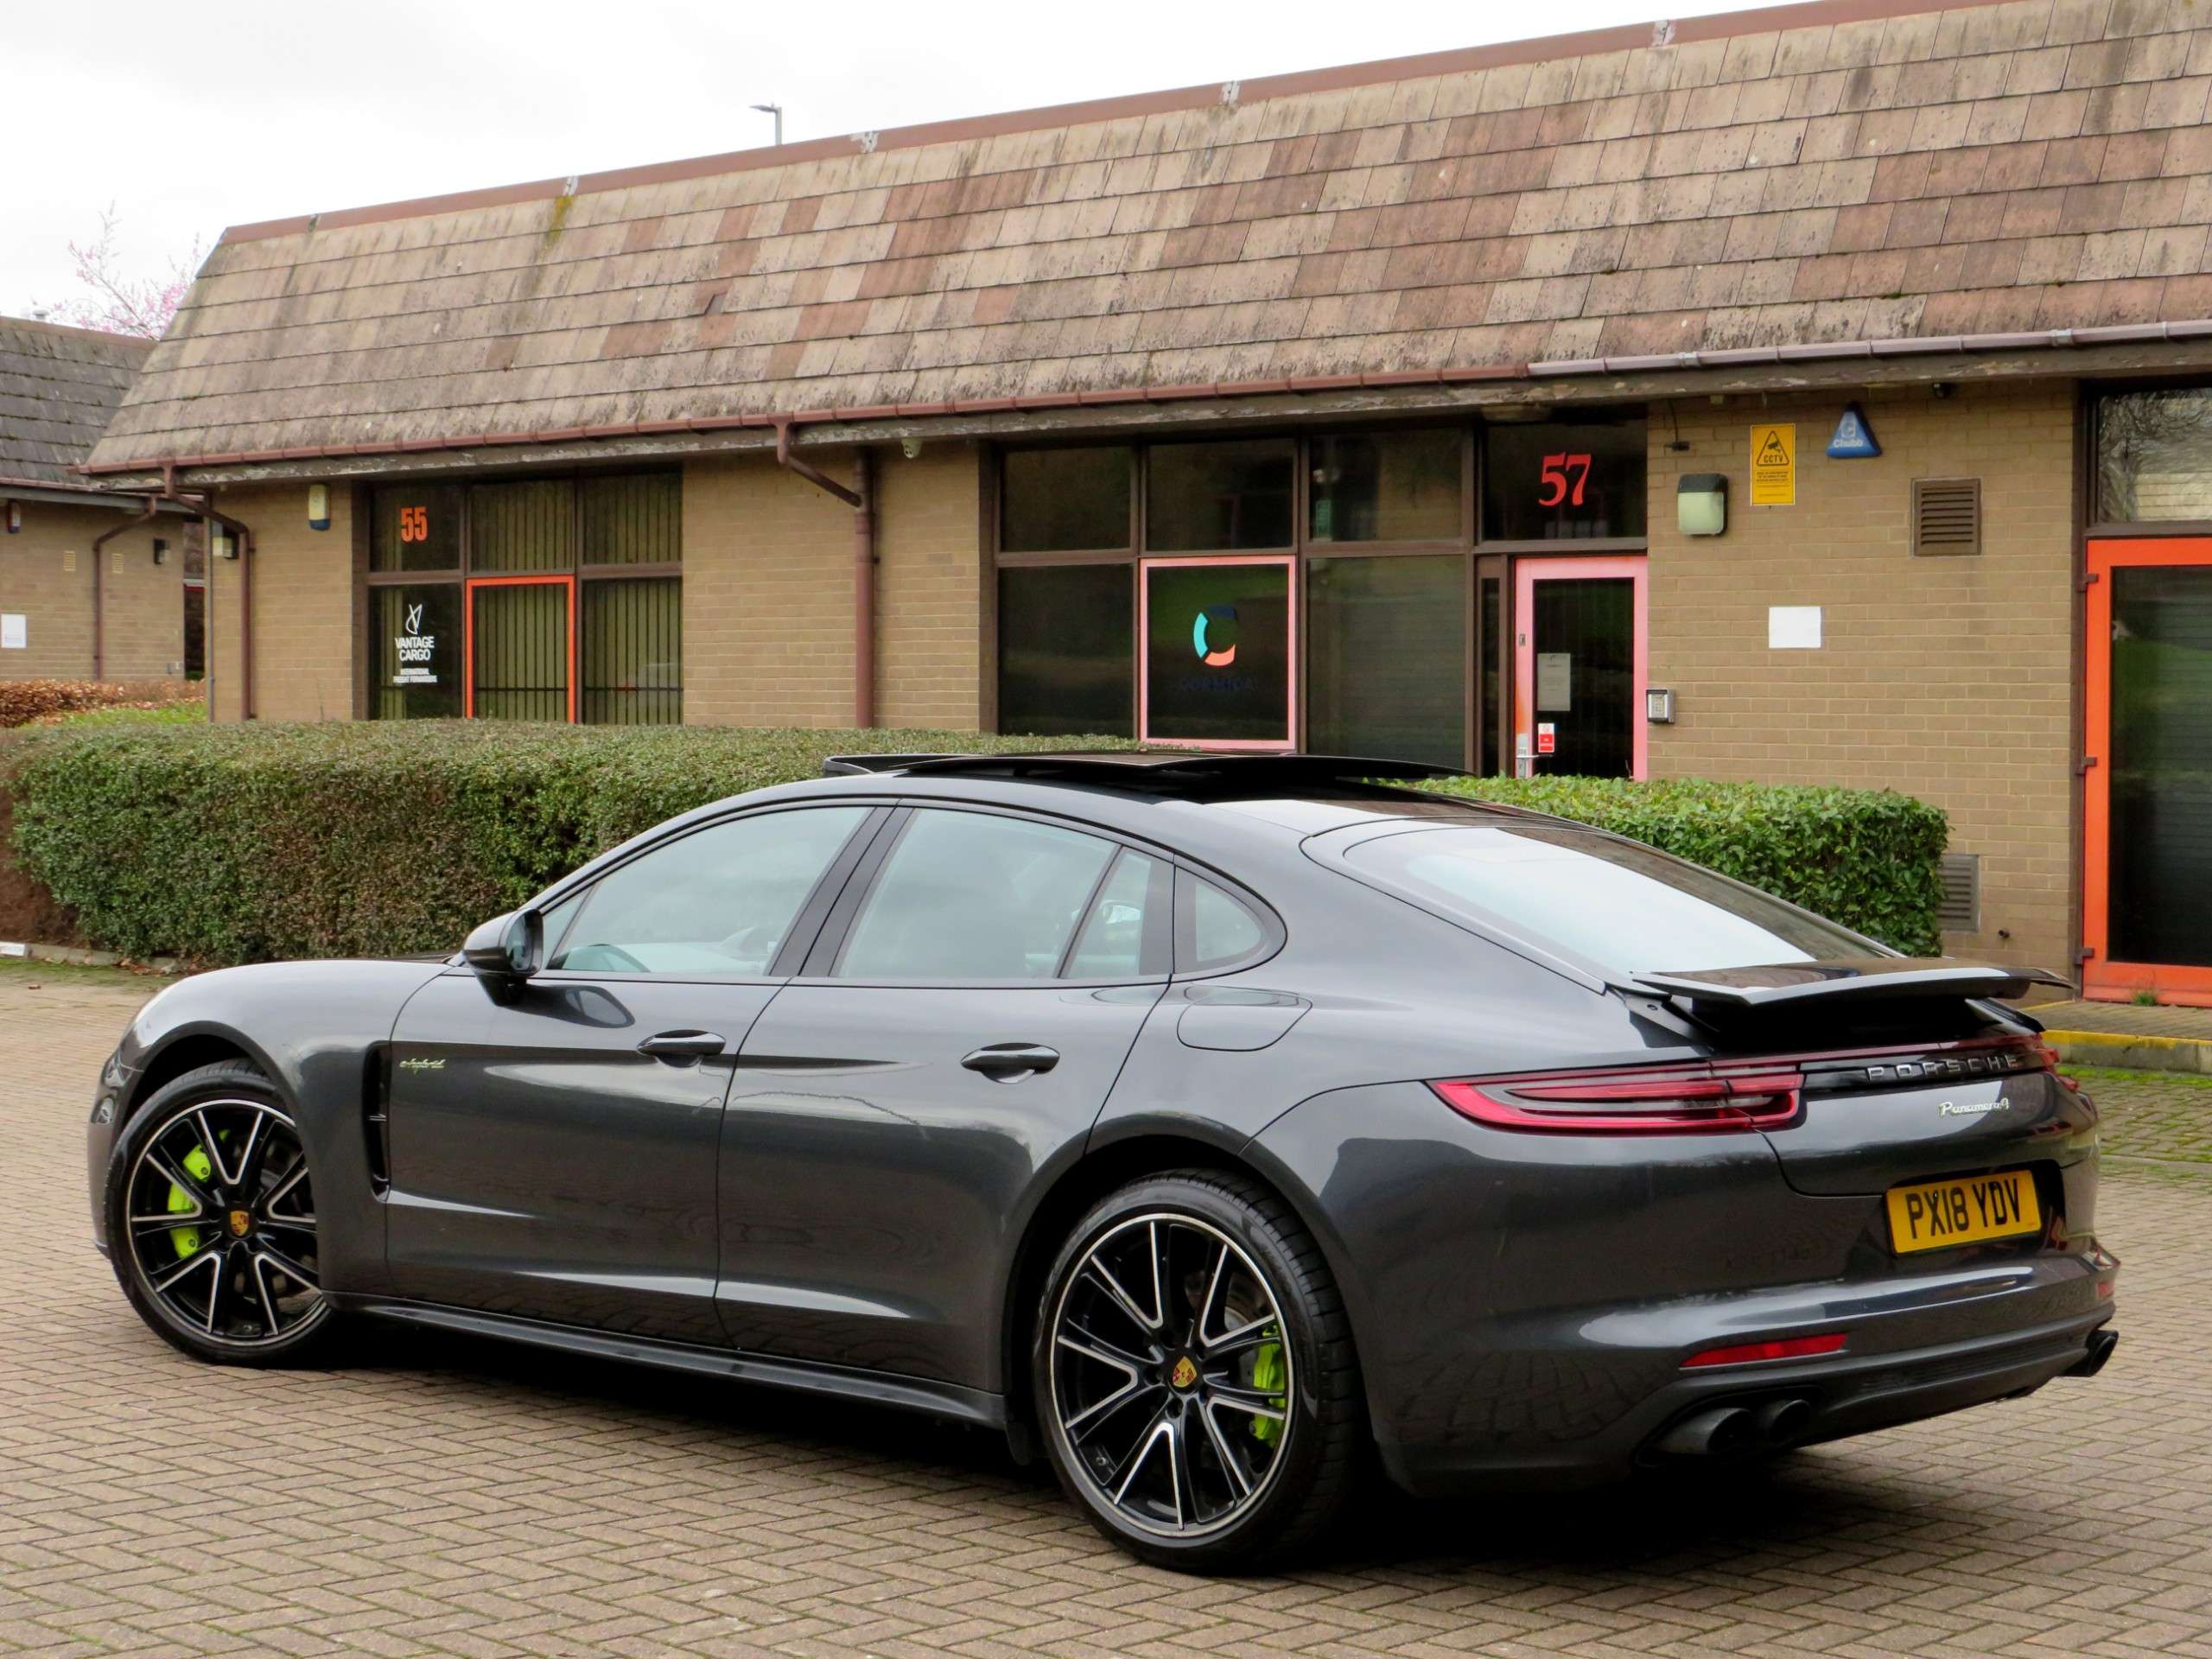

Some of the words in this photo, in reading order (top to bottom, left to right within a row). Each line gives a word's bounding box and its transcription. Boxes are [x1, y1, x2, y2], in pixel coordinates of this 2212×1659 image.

[1833, 438, 1863, 448] Chubb
[1764, 454, 1783, 463] CCTV
[1538, 452, 1592, 506] 57
[401, 506, 428, 542] 55
[394, 636, 435, 649] VANTAGE
[399, 648, 431, 661] CARGO
[1867, 1054, 2019, 1080] PORSCHE
[1904, 1186, 1970, 1239] PX18
[1972, 1178, 2021, 1228] YDV
